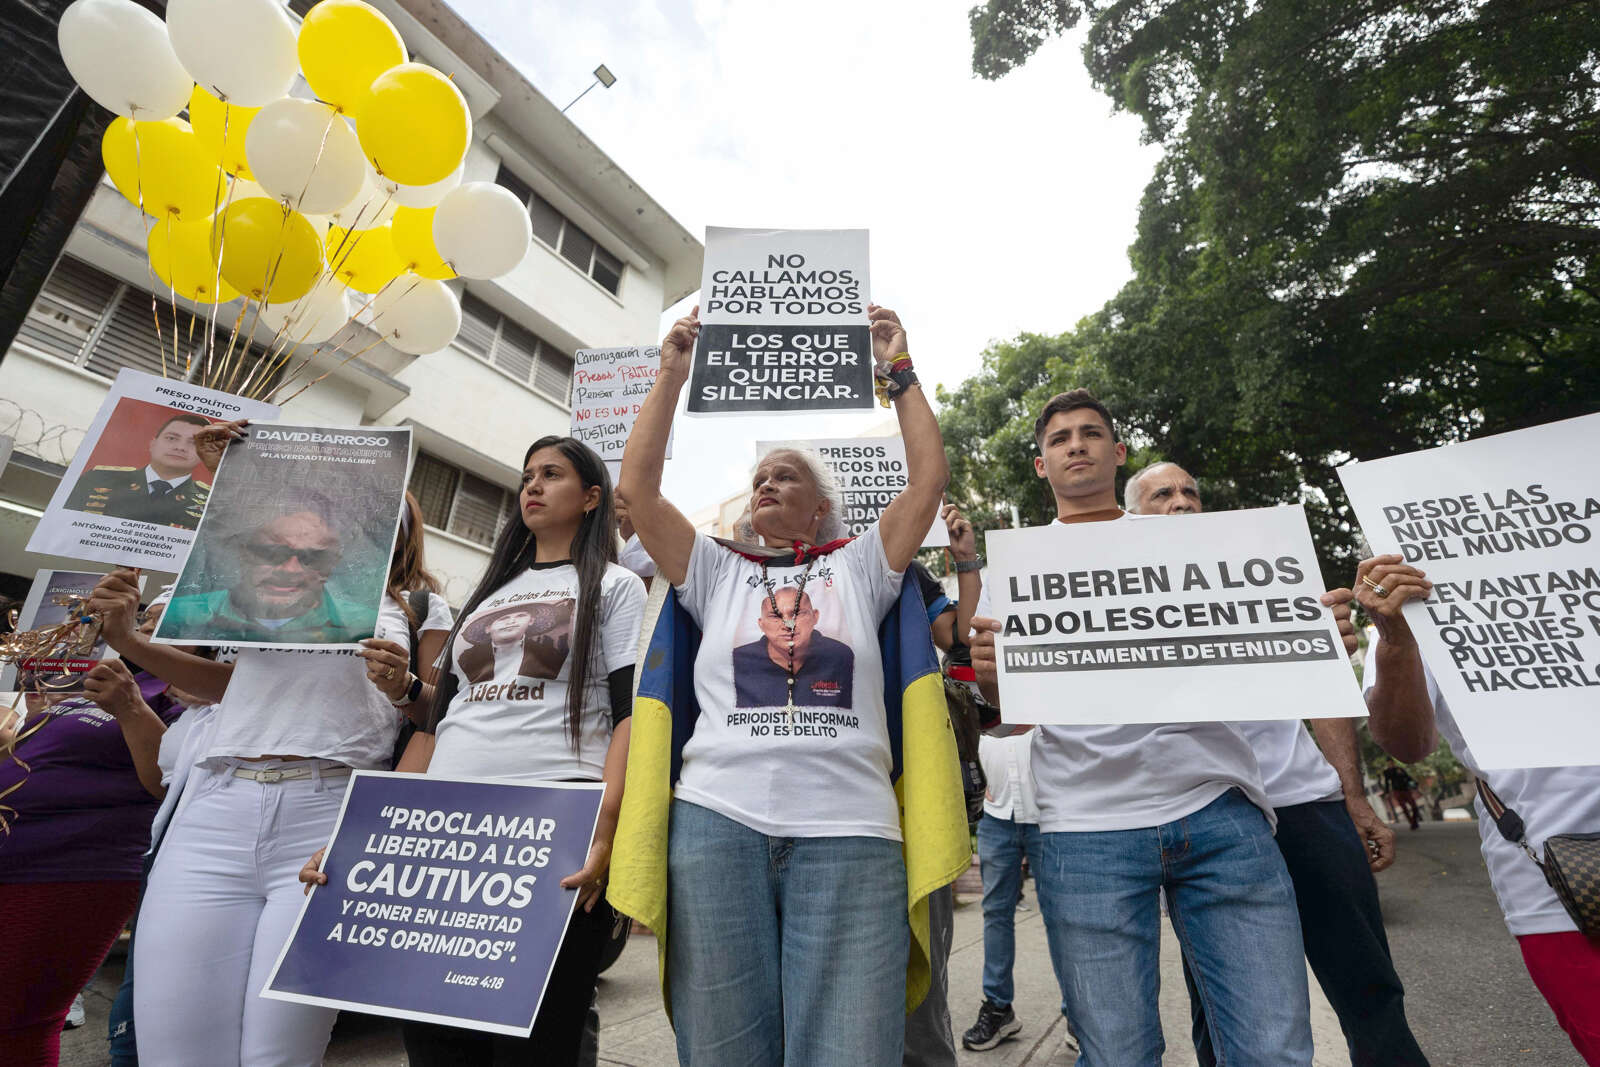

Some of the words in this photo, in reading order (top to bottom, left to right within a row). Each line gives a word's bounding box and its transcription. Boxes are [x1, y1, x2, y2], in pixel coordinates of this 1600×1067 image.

[768, 254, 805, 269] NO
[712, 270, 860, 287] CALLAMOS,
[711, 285, 860, 300] HABLAMOS
[707, 300, 762, 314] POR
[770, 300, 863, 315] TODOS
[732, 334, 784, 349] LOS
[790, 333, 850, 351] QUE
[706, 351, 741, 366] EL
[750, 351, 859, 366] TERROR
[728, 368, 834, 385] QUIERE
[622, 380, 656, 396] distint
[701, 385, 859, 400] SILENCIAR.
[155, 386, 191, 400] PRESO
[192, 395, 241, 412] POLÍTICO
[169, 399, 195, 413] AÑO
[197, 406, 222, 418] 2020
[576, 409, 590, 422] NO
[595, 407, 610, 418] ES
[613, 406, 628, 416] UN
[256, 430, 310, 442] DAVID
[310, 433, 389, 447] BARROSO
[573, 422, 627, 441] JUSTICIA
[595, 439, 628, 453] TOD
[819, 446, 886, 458] PRESOS
[879, 460, 902, 472] NO
[851, 475, 909, 487] ACCES
[1382, 495, 1481, 525] DESDE
[1482, 484, 1550, 511] LAS
[121, 521, 157, 532] CAPITÁN
[90, 531, 139, 545] OPERACIÓN
[166, 536, 191, 546] TORRE
[1400, 540, 1459, 563] DEL
[1462, 523, 1592, 557] MUNDO
[79, 539, 121, 551] RECLUIDO
[134, 546, 143, 554] EL
[144, 548, 172, 558] RODEO
[1009, 565, 1172, 603] LIBEREN
[1182, 563, 1211, 592] A
[1217, 556, 1305, 589] LOS
[508, 592, 540, 603] Carlos
[1003, 596, 1323, 637] ADOLESCENTES
[1426, 600, 1475, 627] LA
[1472, 595, 1556, 622] VOZ
[1439, 616, 1585, 649] QUIENES
[1006, 644, 1178, 667] INJUSTAMENTE
[1181, 637, 1331, 660] DETENIDOS
[1449, 641, 1584, 670] PUEDEN
[1459, 662, 1600, 693] HACERL
[799, 712, 859, 729] INFORMAR
[750, 726, 770, 737] NO
[773, 726, 790, 736] ES
[794, 726, 837, 738] DELITO
[380, 806, 556, 841] “PROCLAMAR
[365, 833, 477, 862] LIBERTAD
[479, 843, 498, 863] A
[503, 845, 552, 868] LOS
[346, 860, 537, 908] CAUTIVOS
[340, 899, 354, 915] Y
[353, 902, 413, 923] PONER
[414, 908, 439, 925] EN
[439, 911, 522, 934] LIBERTAD
[326, 922, 344, 942] A
[347, 924, 389, 947] LOS
[444, 971, 479, 987] Lucas
[480, 976, 505, 990] 4:18
